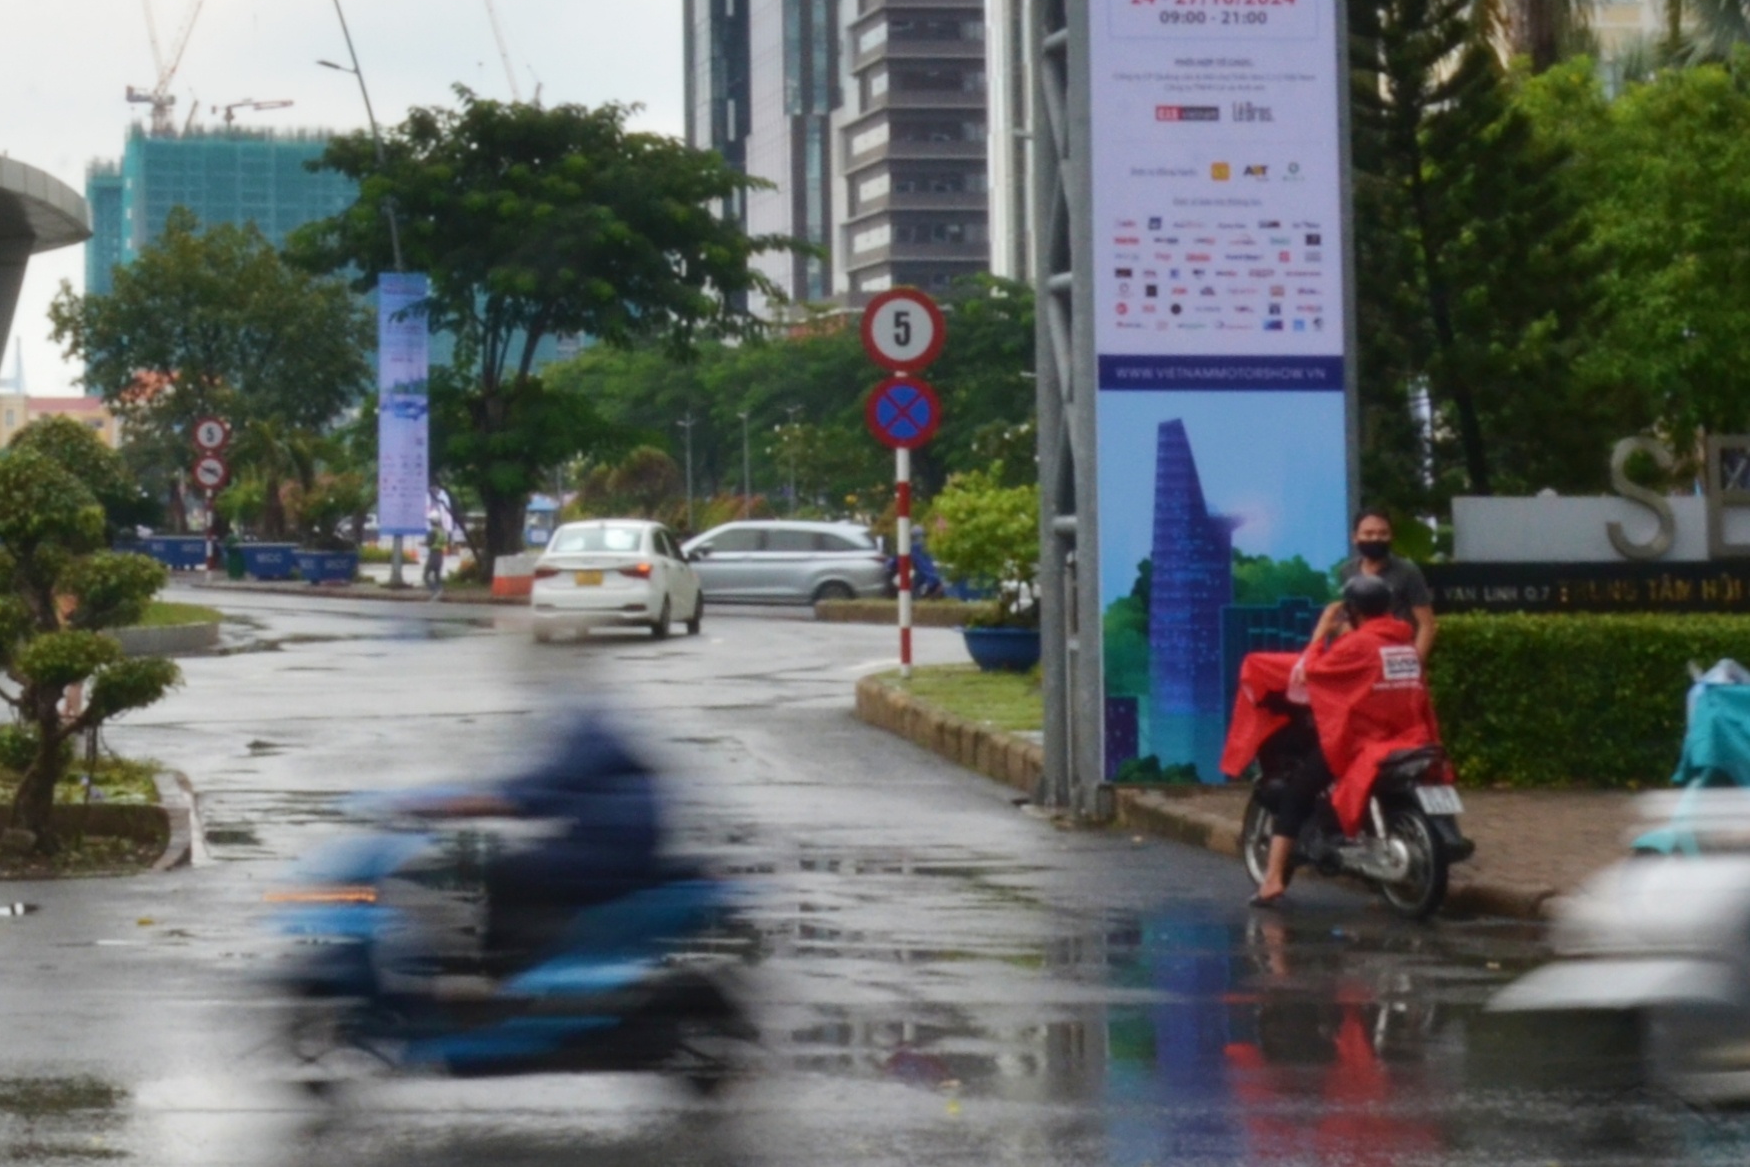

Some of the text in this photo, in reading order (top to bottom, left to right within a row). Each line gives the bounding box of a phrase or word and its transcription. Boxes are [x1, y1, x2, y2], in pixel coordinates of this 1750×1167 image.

[1159, 11, 1206, 24] 09:00
[1220, 11, 1267, 24] 21:00
[894, 310, 911, 347] 5
